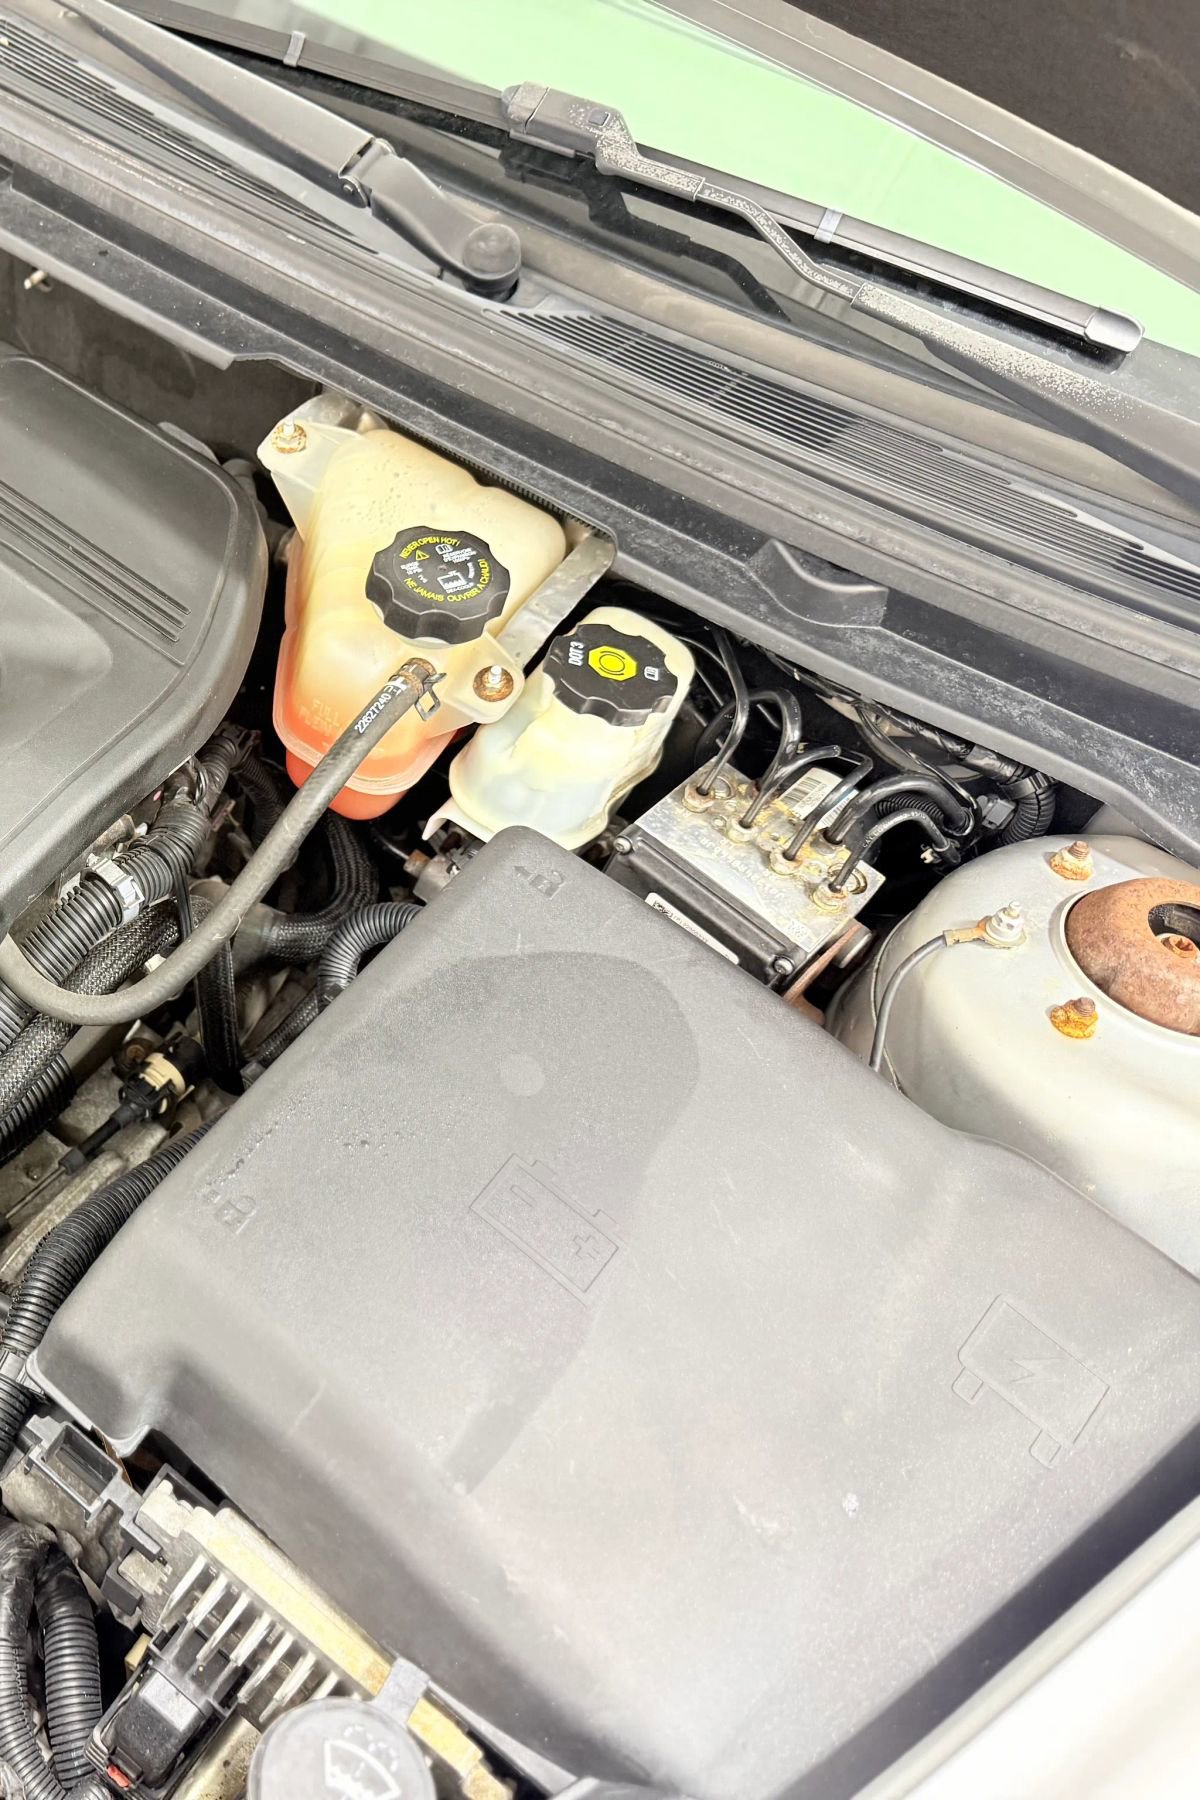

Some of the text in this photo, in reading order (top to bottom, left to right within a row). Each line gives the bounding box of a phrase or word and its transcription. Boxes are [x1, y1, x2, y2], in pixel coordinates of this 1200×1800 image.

[400, 541, 420, 559] NEVER
[417, 536, 440, 546] OPEN
[404, 577, 417, 588] NE
[414, 586, 444, 602] JAMAIS
[446, 587, 481, 602] OUVRIR
[568, 641, 585, 666] DOT 3
